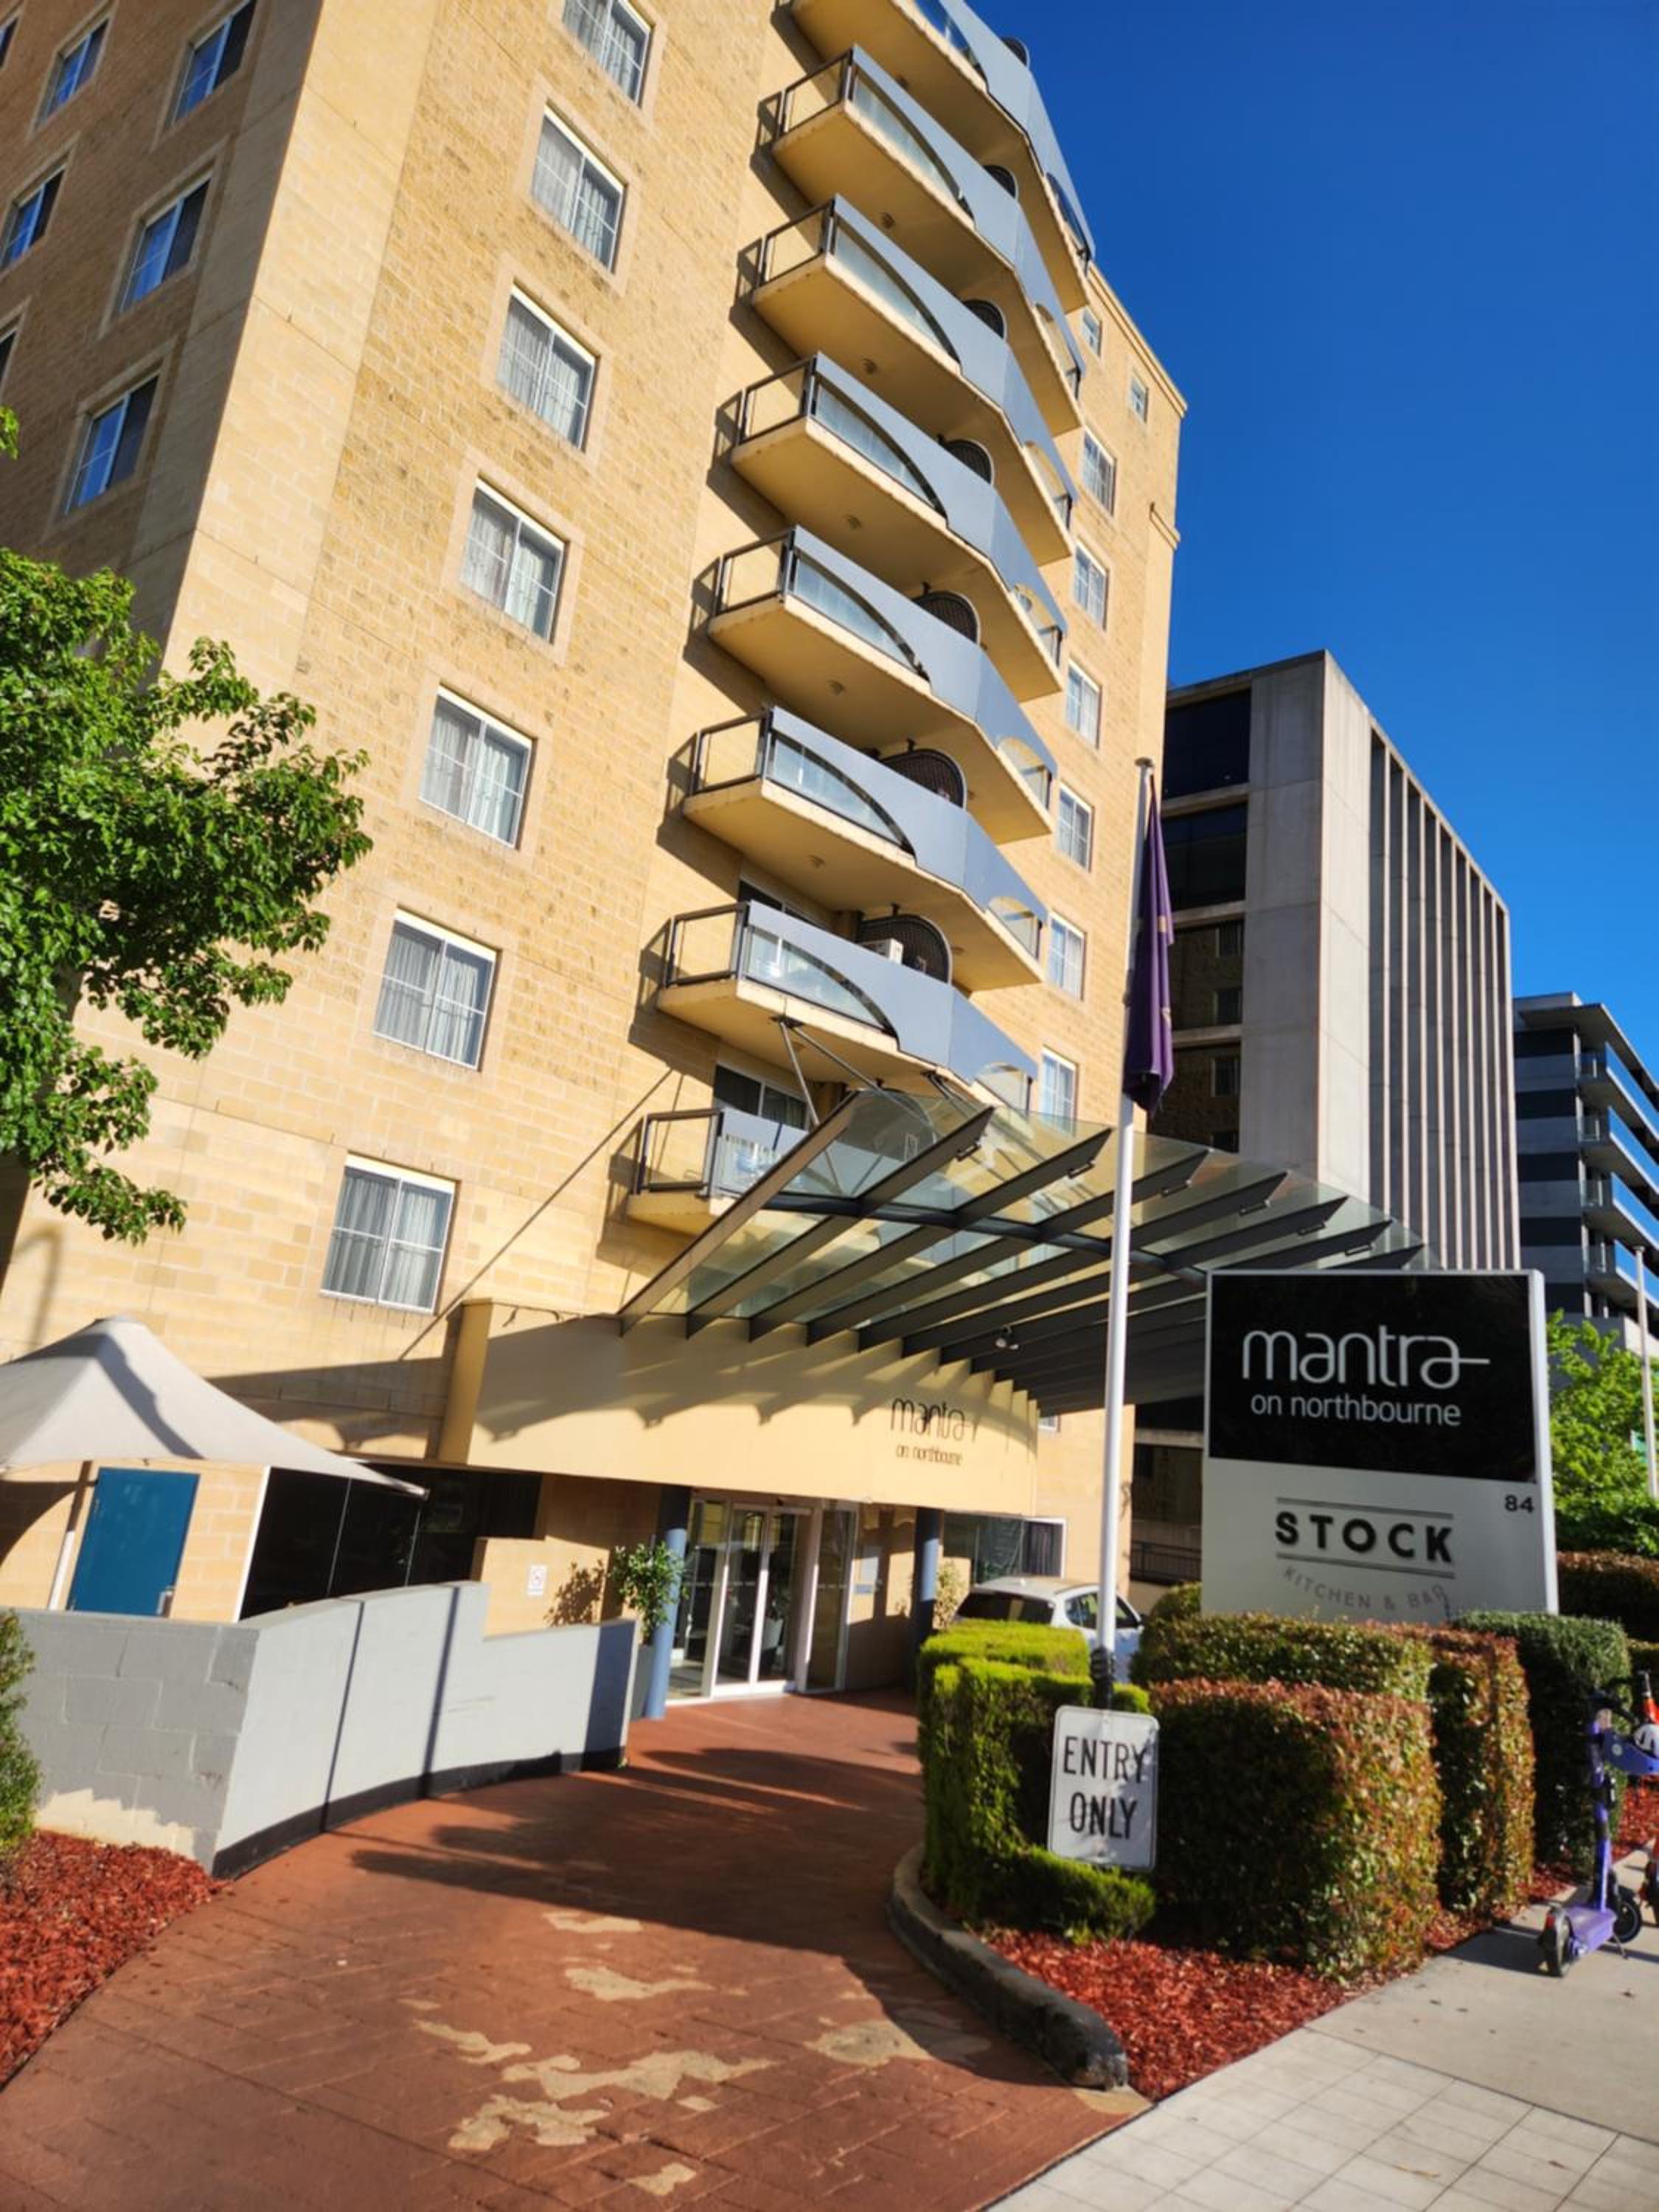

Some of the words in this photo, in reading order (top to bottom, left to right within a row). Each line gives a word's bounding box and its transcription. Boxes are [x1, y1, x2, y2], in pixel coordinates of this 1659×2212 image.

[1242, 1325, 1490, 1389] mantra
[1251, 1394, 1282, 1416] on
[1290, 1394, 1461, 1427] northbourne
[1504, 1495, 1534, 1514] 84
[1275, 1510, 1453, 1564] STOCK
[1284, 1564, 1371, 1609] KITCHEN
[1063, 1736, 1149, 1784] ENTRY
[1071, 1791, 1138, 1840] ONLY
